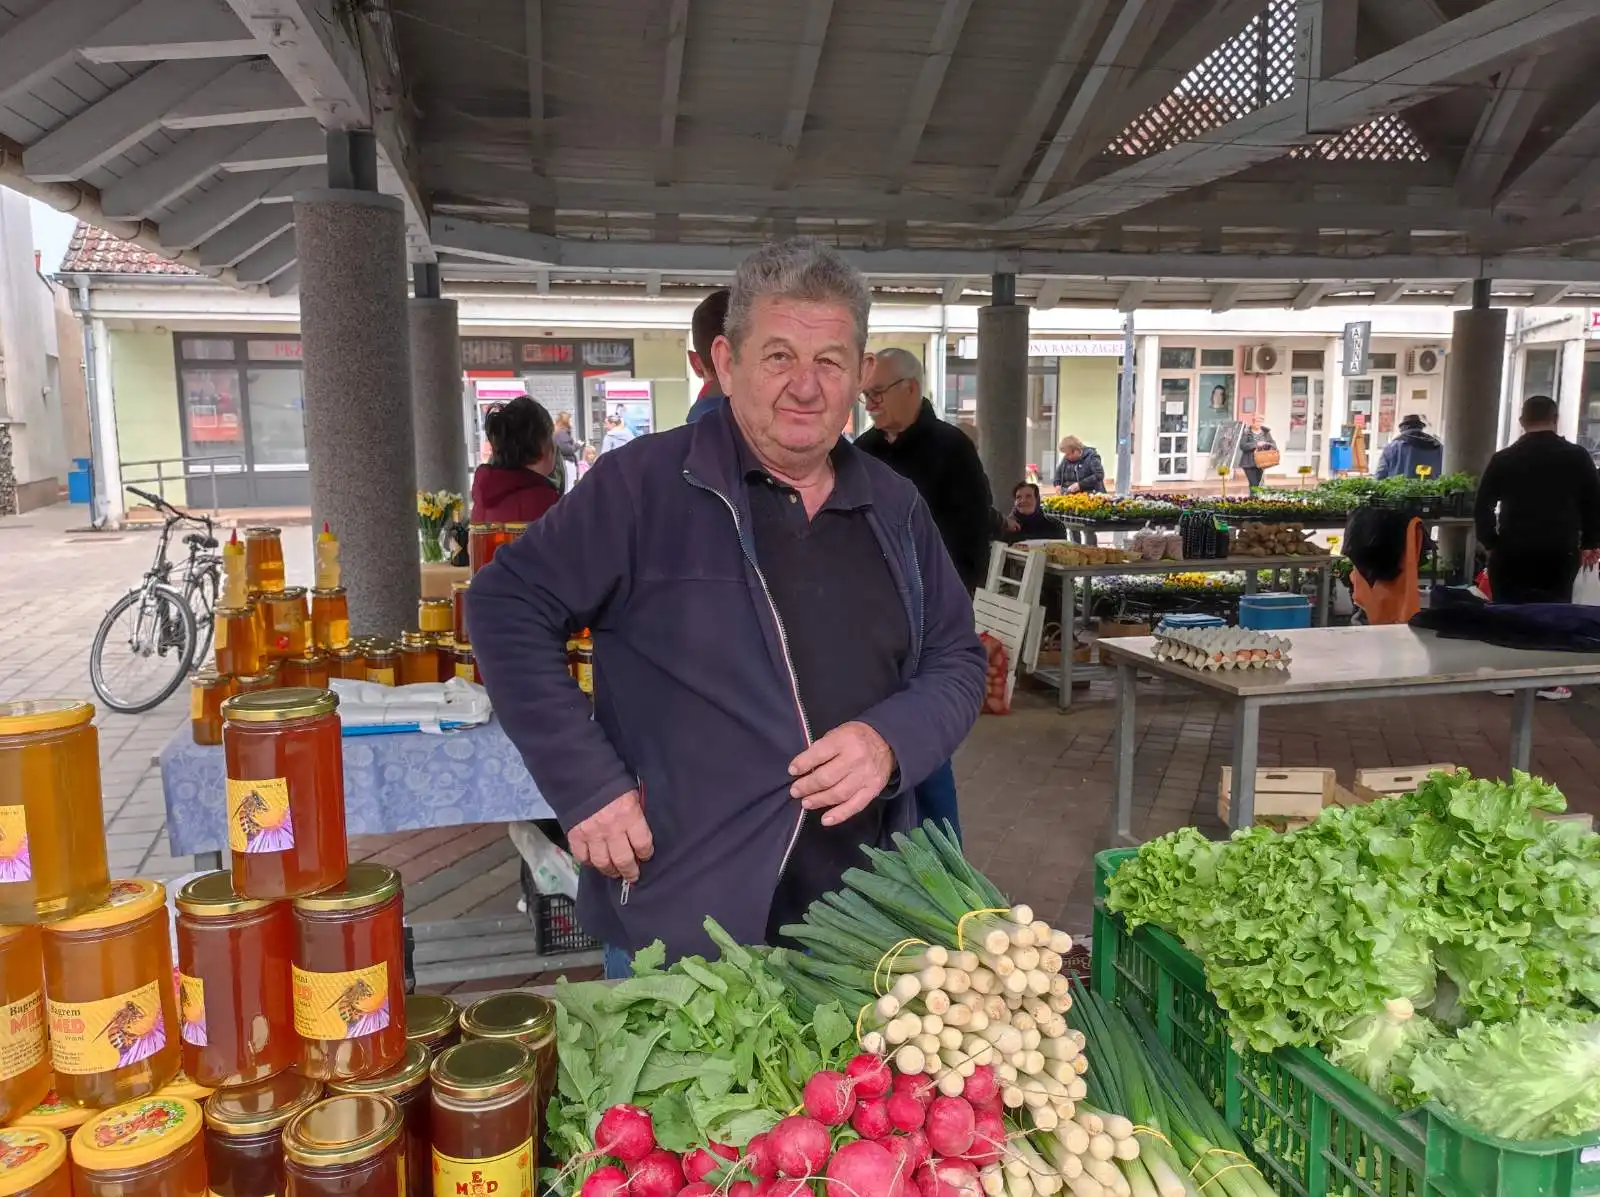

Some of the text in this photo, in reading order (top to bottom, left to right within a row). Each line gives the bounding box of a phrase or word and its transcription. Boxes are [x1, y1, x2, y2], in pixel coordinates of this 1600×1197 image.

[1052, 344, 1088, 353] BANKA
[1351, 328, 1362, 370] ANNA
[53, 1018, 86, 1034] MED
